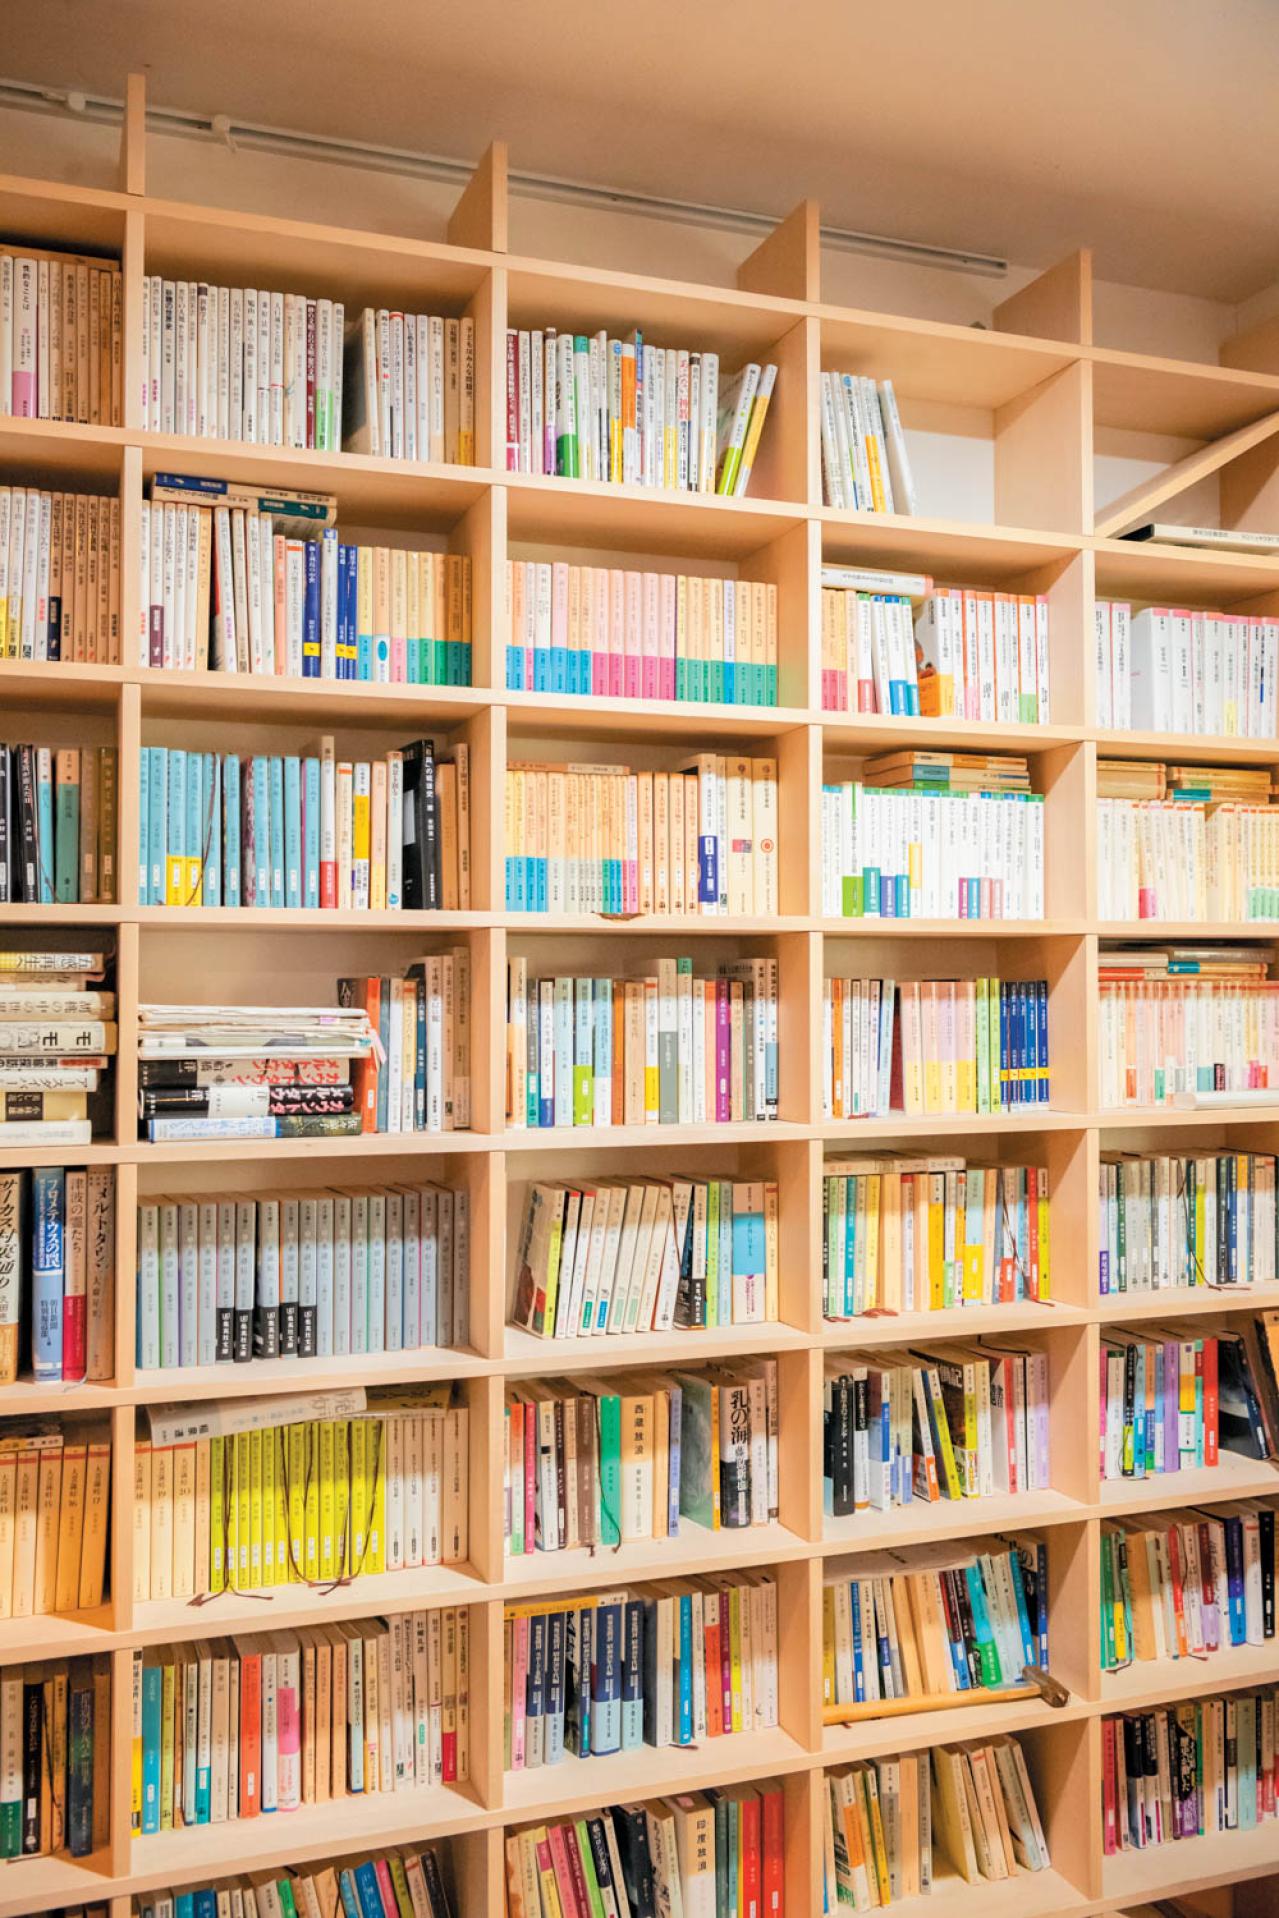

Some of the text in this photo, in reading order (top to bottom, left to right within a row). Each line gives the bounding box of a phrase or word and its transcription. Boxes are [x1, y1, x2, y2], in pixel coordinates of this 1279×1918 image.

[7, 1078, 88, 1089] アースダイバー
[252, 1058, 340, 1071] メルトダウン
[270, 1101, 344, 1114] カウントダ
[47, 1179, 61, 1269] プロメテウスの罠
[71, 1178, 84, 1253] 津波の霊たち
[94, 1188, 110, 1271] メルトダウン
[634, 1404, 644, 1454] 西蔵放浪
[731, 1389, 747, 1445] 乳の海
[697, 1820, 707, 1872] 印度放浪
